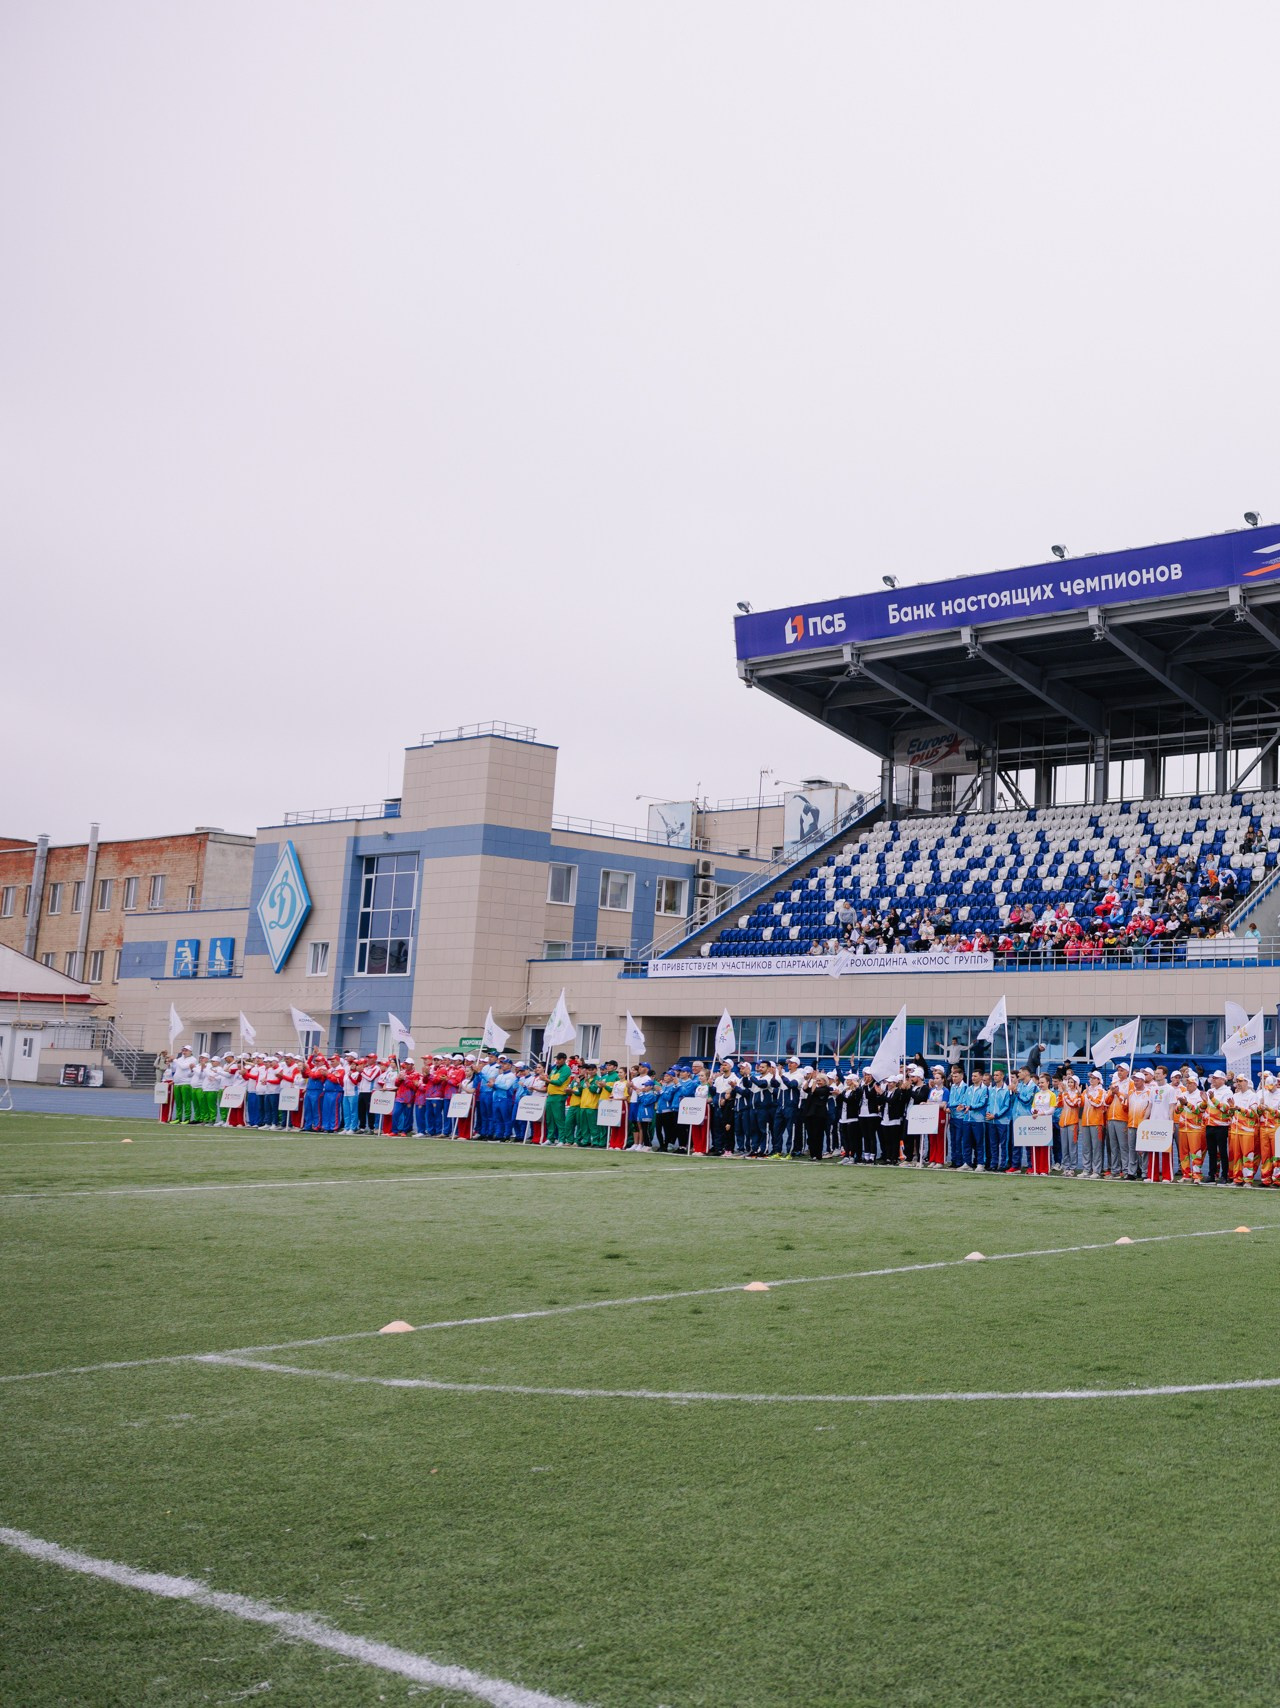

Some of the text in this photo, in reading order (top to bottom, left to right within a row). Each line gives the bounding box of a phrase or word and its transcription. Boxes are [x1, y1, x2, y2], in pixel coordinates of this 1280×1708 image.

[888, 562, 1183, 625] Банк настоящих чемпионов
[808, 612, 847, 637] ПСБ
[661, 954, 988, 972] ПРИВЕТСТВУЕМ УЧАСТНИКОВ СПАРТАКИАД РОХОЛДИНГА «КОМОС ГРУПП»
